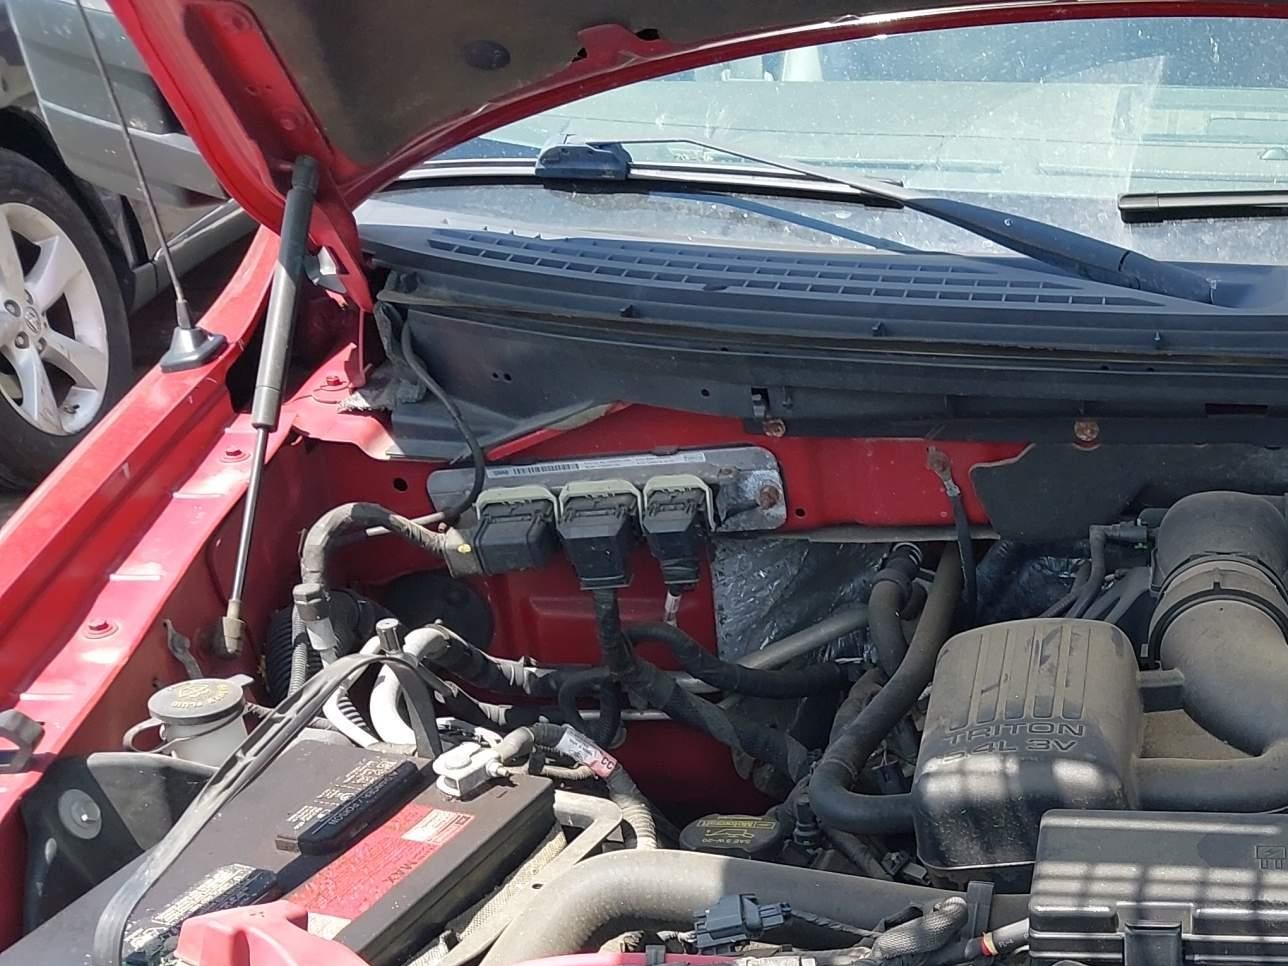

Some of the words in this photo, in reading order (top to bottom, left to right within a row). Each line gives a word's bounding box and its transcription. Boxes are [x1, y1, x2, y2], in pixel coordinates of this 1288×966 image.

[943, 721, 1086, 745] TRITON
[1025, 738, 1078, 752] 3V
[600, 756, 615, 770] CC
